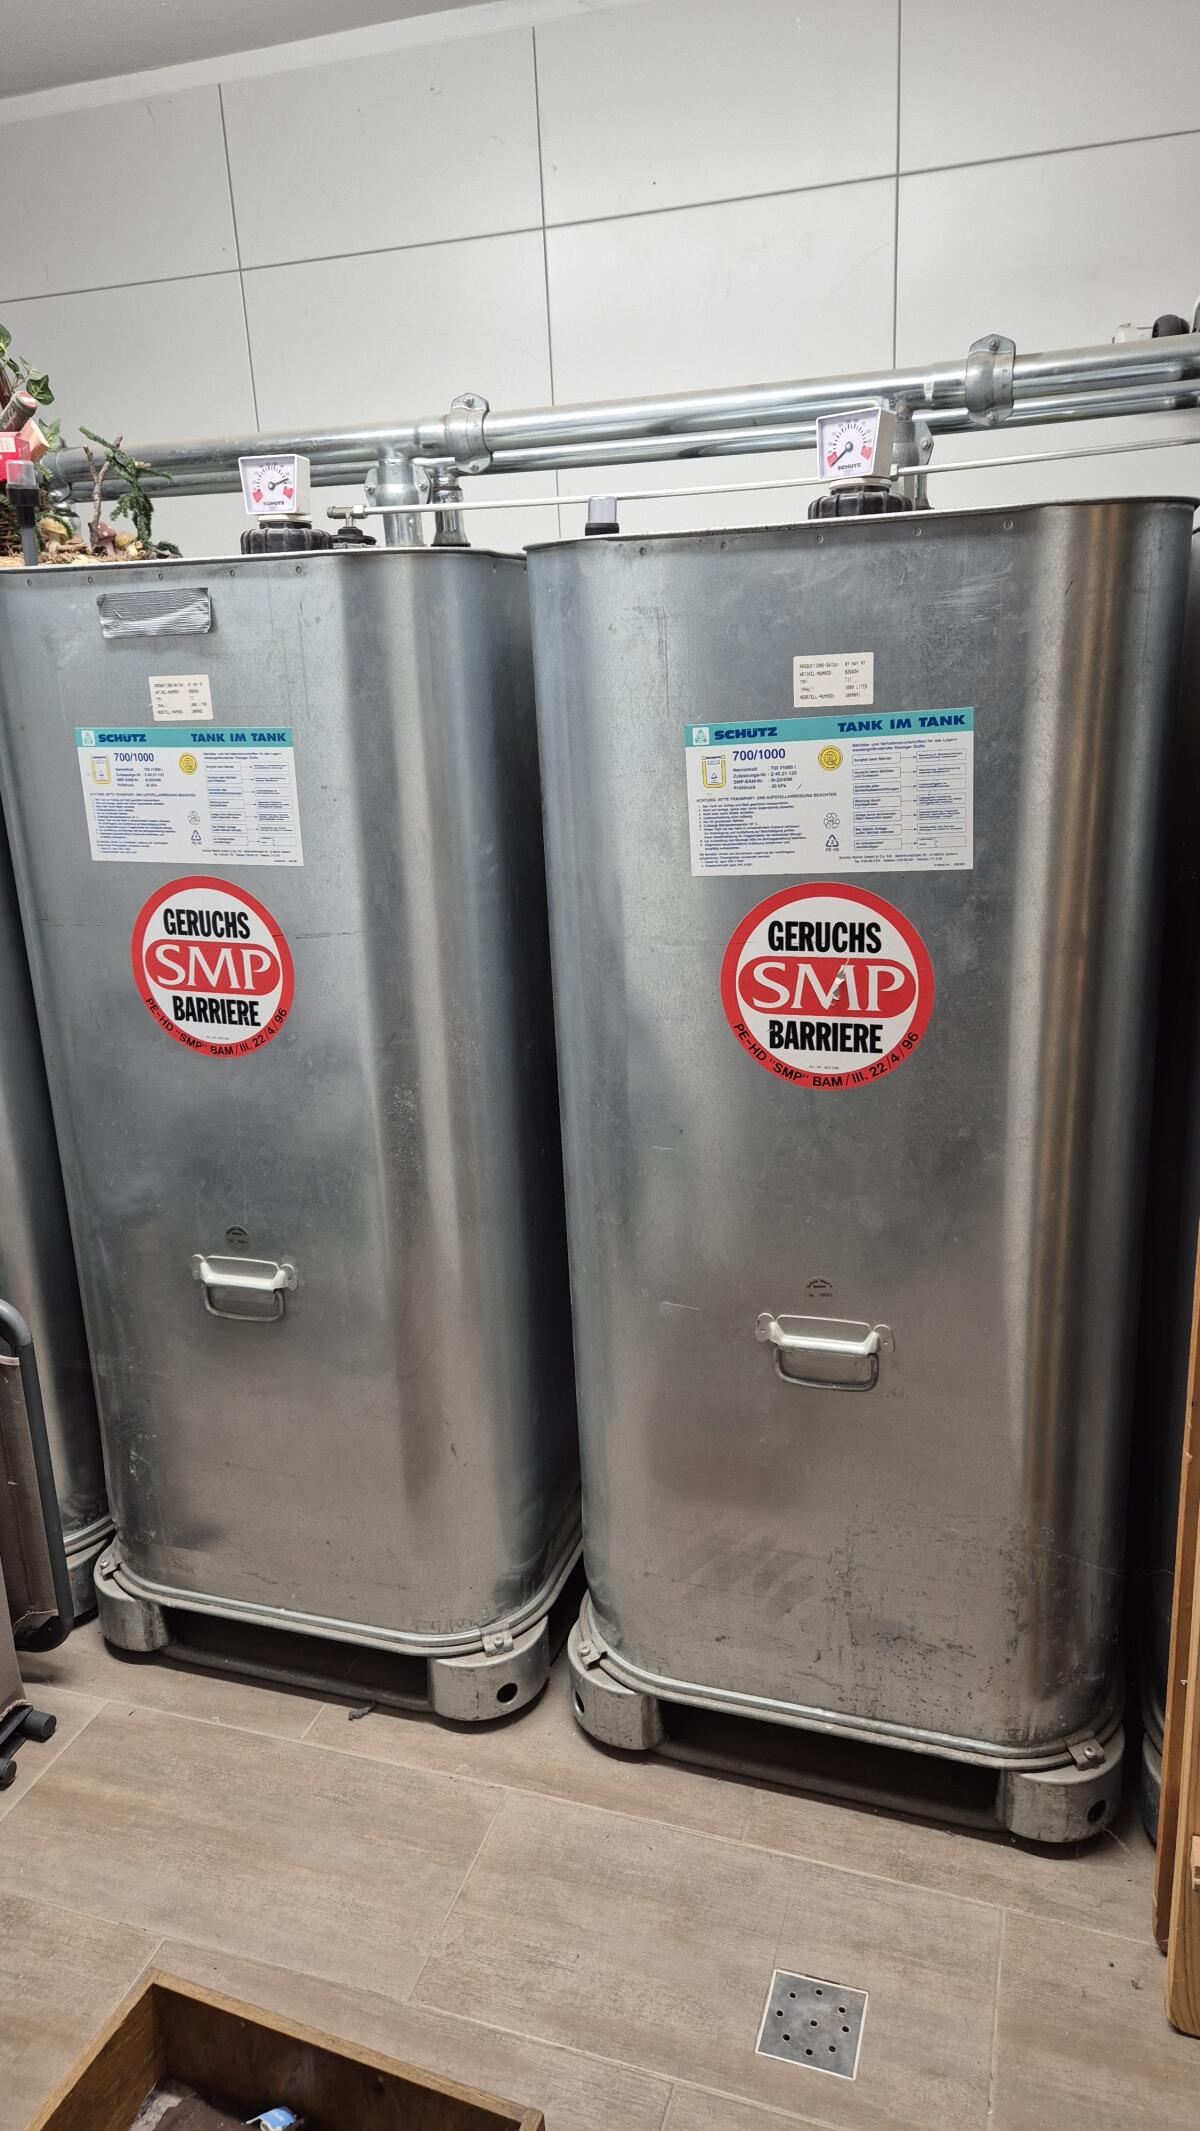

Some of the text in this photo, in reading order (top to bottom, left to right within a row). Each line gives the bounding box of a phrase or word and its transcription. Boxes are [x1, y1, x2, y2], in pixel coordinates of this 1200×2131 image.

[191, 732, 286, 743] TANK IM TANK
[837, 715, 966, 732] TANK IM TANK
[114, 753, 154, 762] 700/1000
[732, 748, 786, 761] 700/1000
[163, 908, 250, 939] GERUCHS
[768, 920, 882, 954] GERUCHS
[155, 944, 271, 990] SMP
[752, 961, 906, 1012] SMP
[146, 998, 174, 1032] PE-HD
[172, 995, 261, 1027] BARRIERE
[734, 1023, 767, 1062] PE-HD
[769, 1020, 883, 1053] BARRIERE
